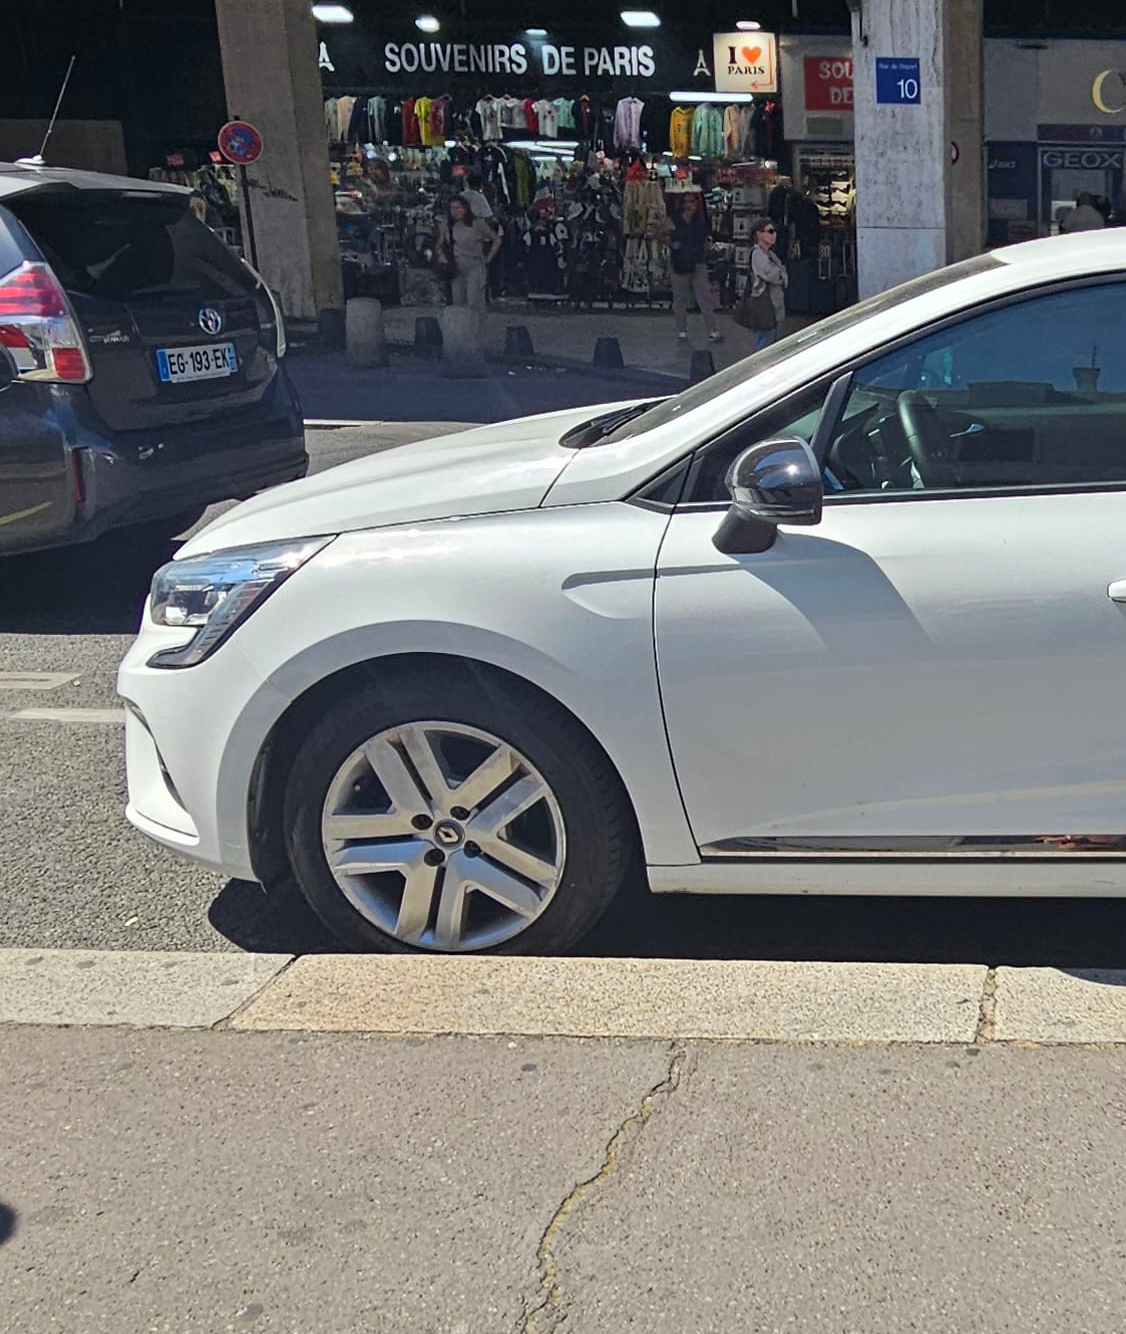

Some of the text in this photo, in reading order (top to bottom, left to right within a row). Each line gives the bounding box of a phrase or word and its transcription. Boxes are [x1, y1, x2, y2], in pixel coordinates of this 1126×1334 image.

[384, 42, 656, 78] SOUVENIRS DE PARIS
[727, 64, 766, 76] PARIS
[896, 78, 918, 100] 10
[1042, 151, 1122, 169] GEOX
[168, 348, 230, 375] EG-193-EK
